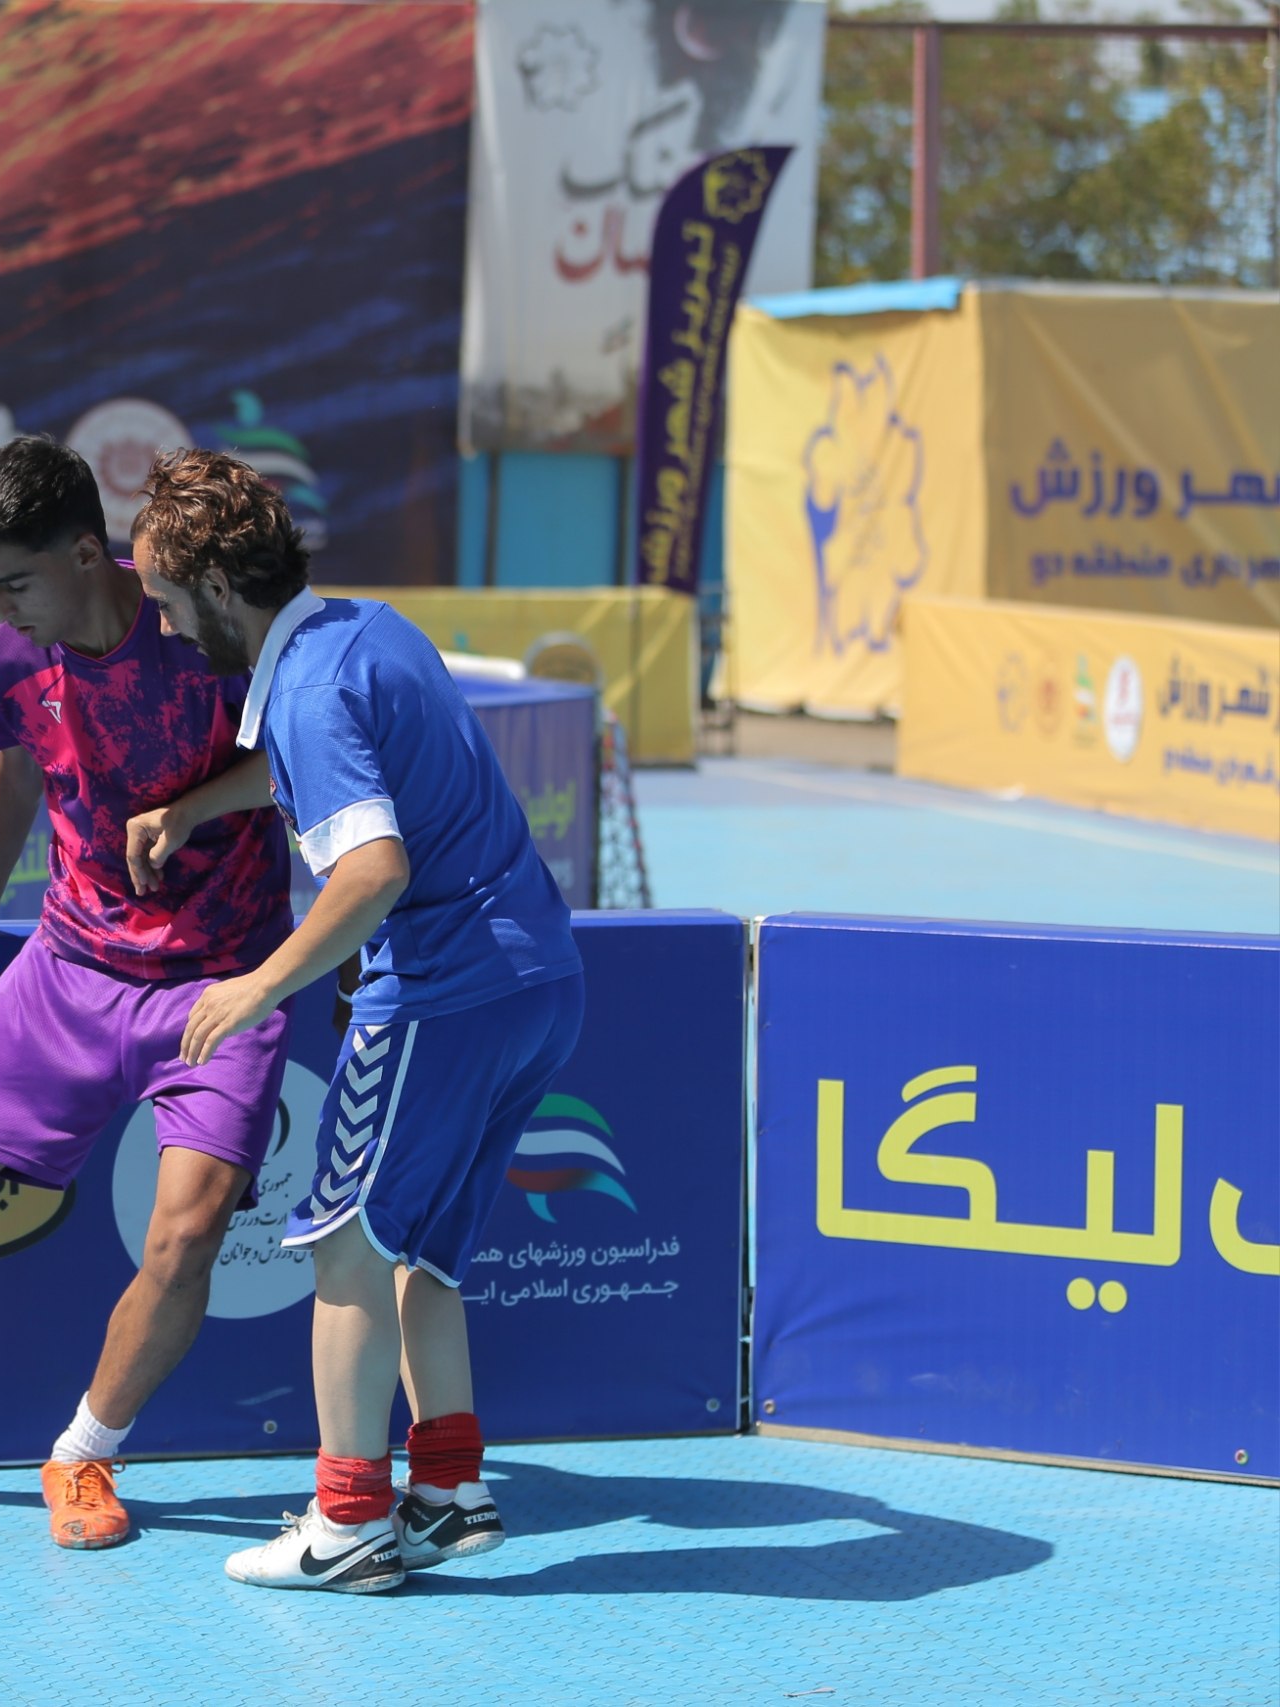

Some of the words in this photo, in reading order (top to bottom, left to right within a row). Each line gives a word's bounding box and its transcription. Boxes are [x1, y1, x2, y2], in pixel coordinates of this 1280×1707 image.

[817, 1065, 1184, 1313] لیگا
[508, 1240, 586, 1269] ورزشهای
[591, 1236, 680, 1266] فدراسیون
[500, 1278, 568, 1306] اسلامی
[572, 1279, 679, 1304] جمهوری
[463, 1511, 501, 1525] TIEMP
